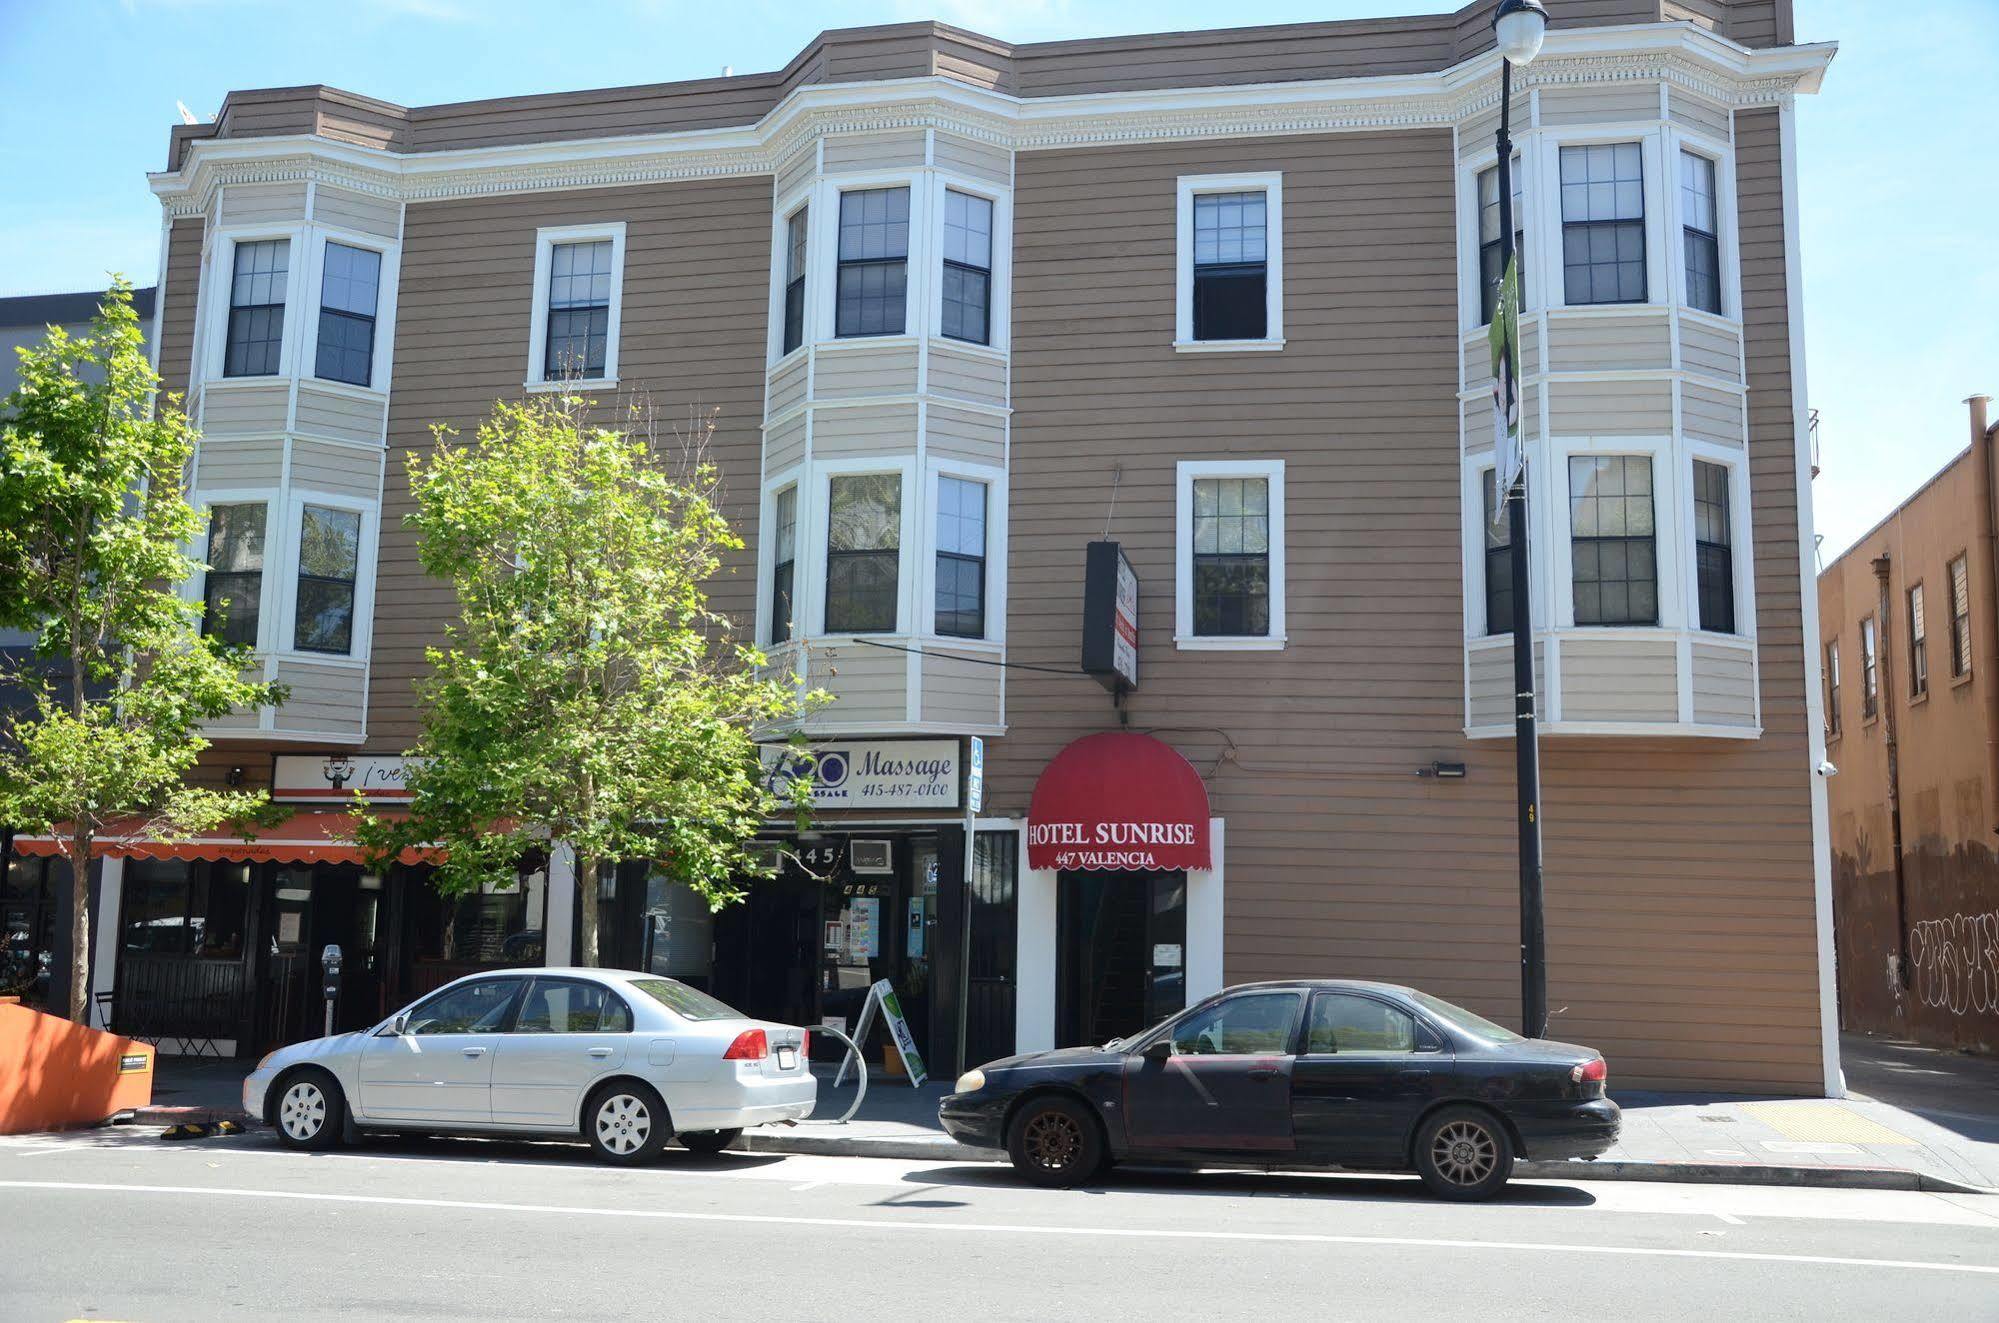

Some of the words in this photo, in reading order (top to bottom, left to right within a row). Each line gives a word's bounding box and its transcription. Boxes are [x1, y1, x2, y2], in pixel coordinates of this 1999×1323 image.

[856, 751, 952, 783] Massage
[861, 784, 949, 796] 415-487-0100
[1029, 823, 1090, 845] HOTEL
[1095, 823, 1195, 845] SUNRISE
[1055, 852, 1075, 865] 447
[1078, 852, 1155, 865] VALENCIA
